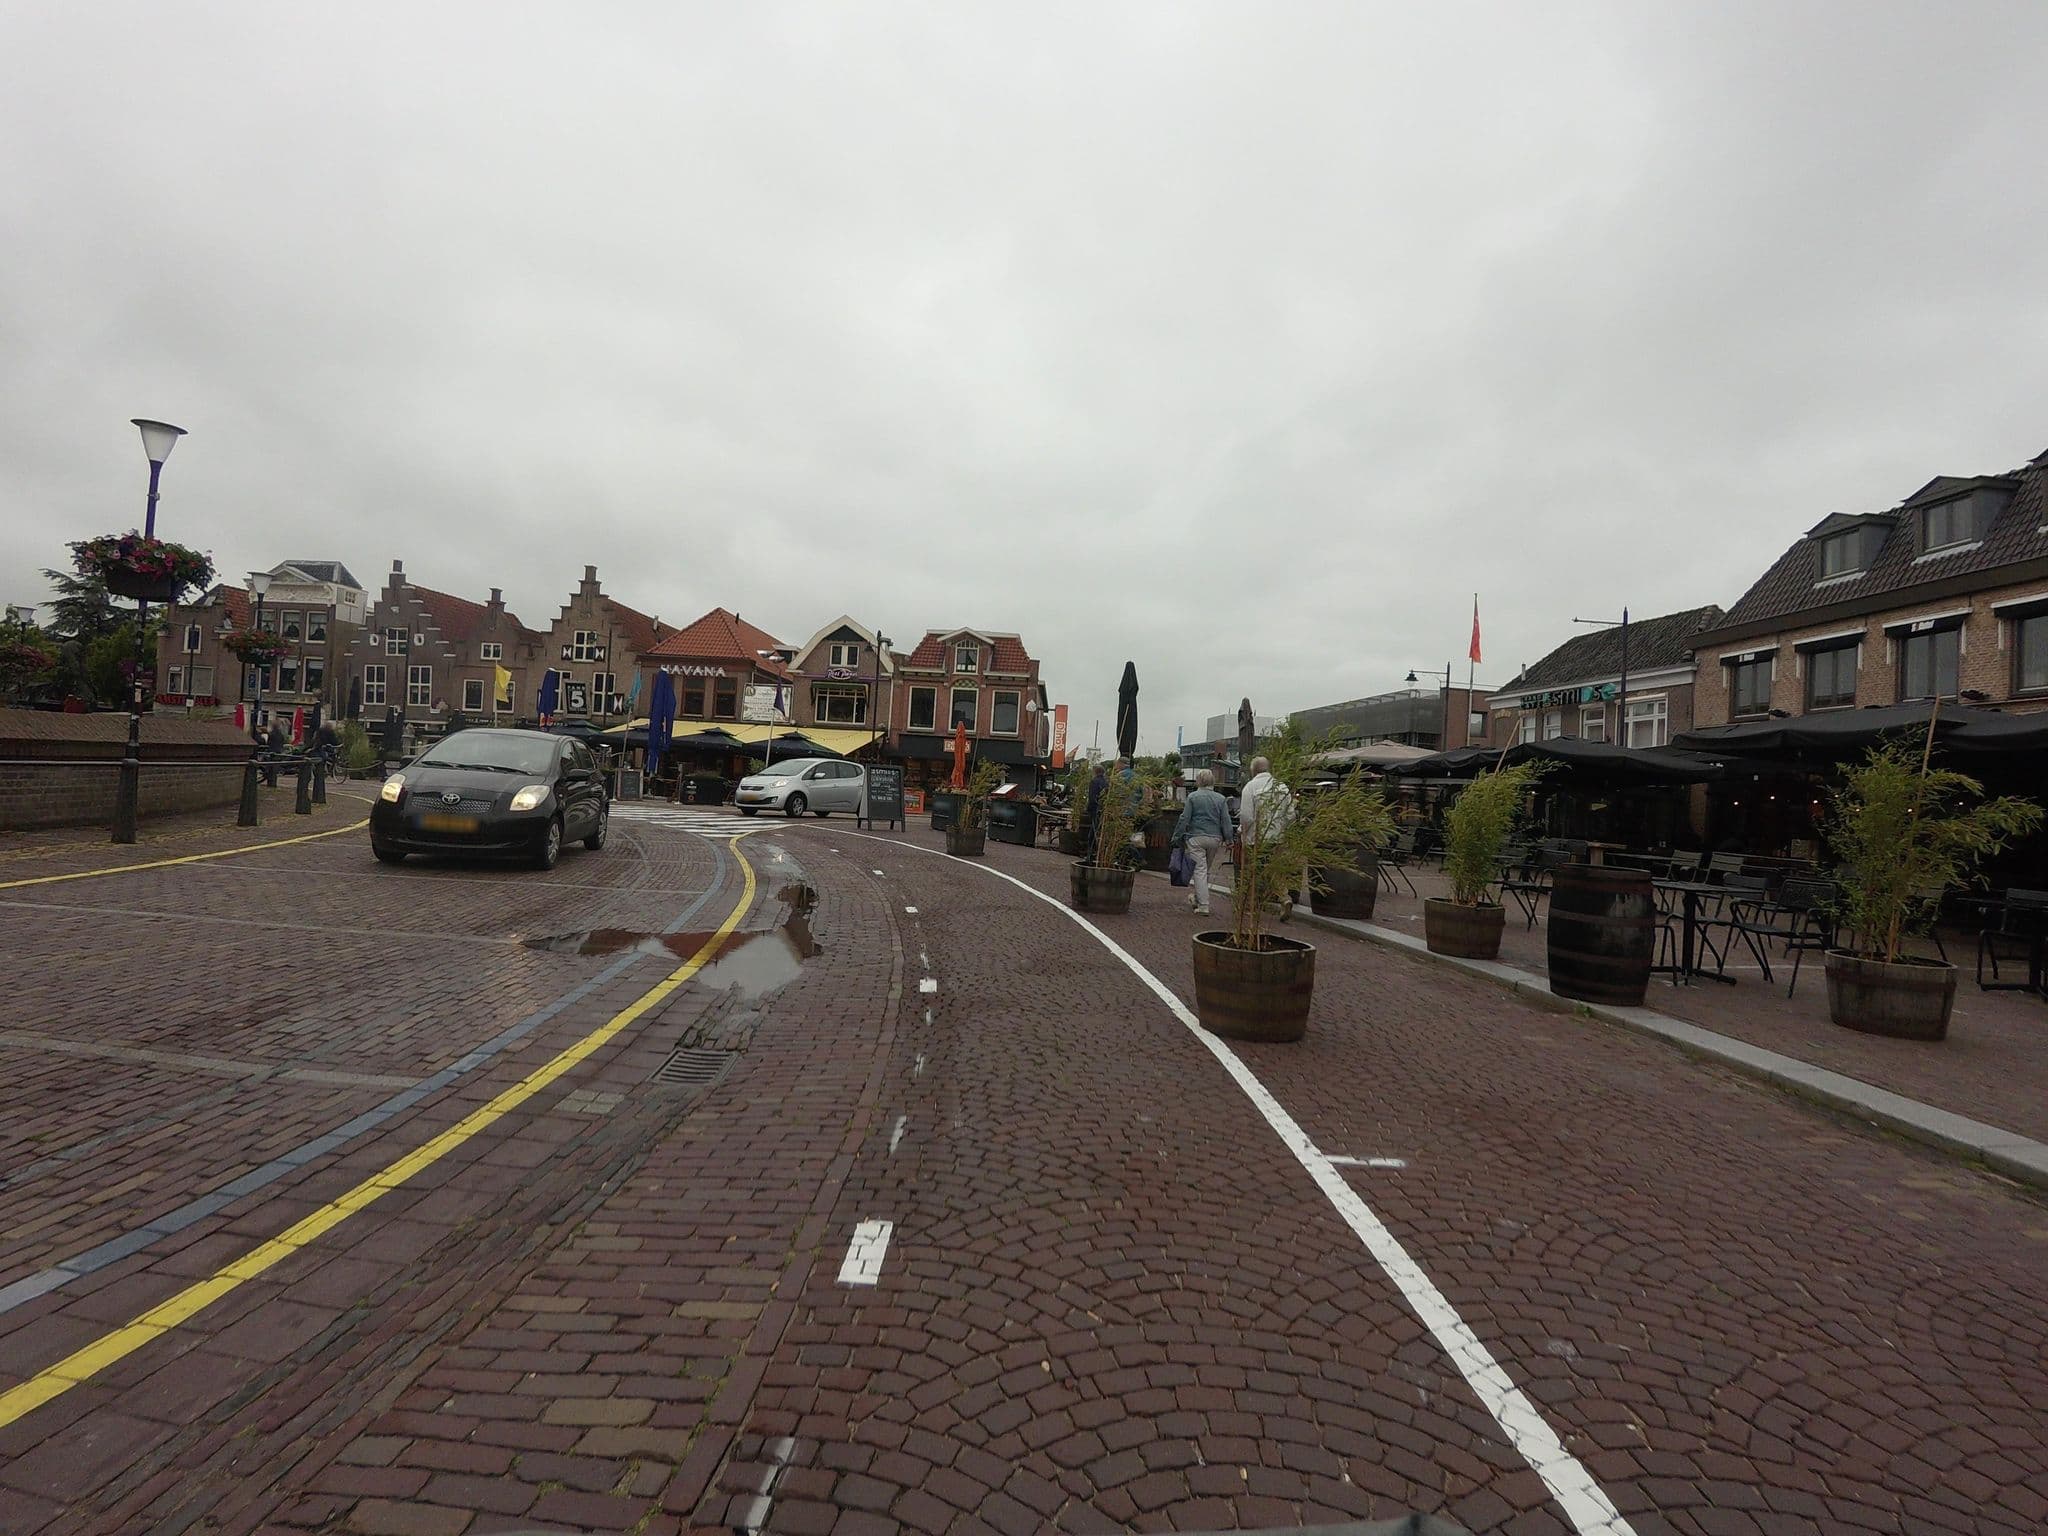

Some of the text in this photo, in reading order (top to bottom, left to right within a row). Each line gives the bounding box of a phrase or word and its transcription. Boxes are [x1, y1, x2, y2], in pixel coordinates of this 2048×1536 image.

[660, 664, 727, 677] HAVANA
[571, 690, 584, 708] 5
[1055, 721, 1065, 752] Dino's
